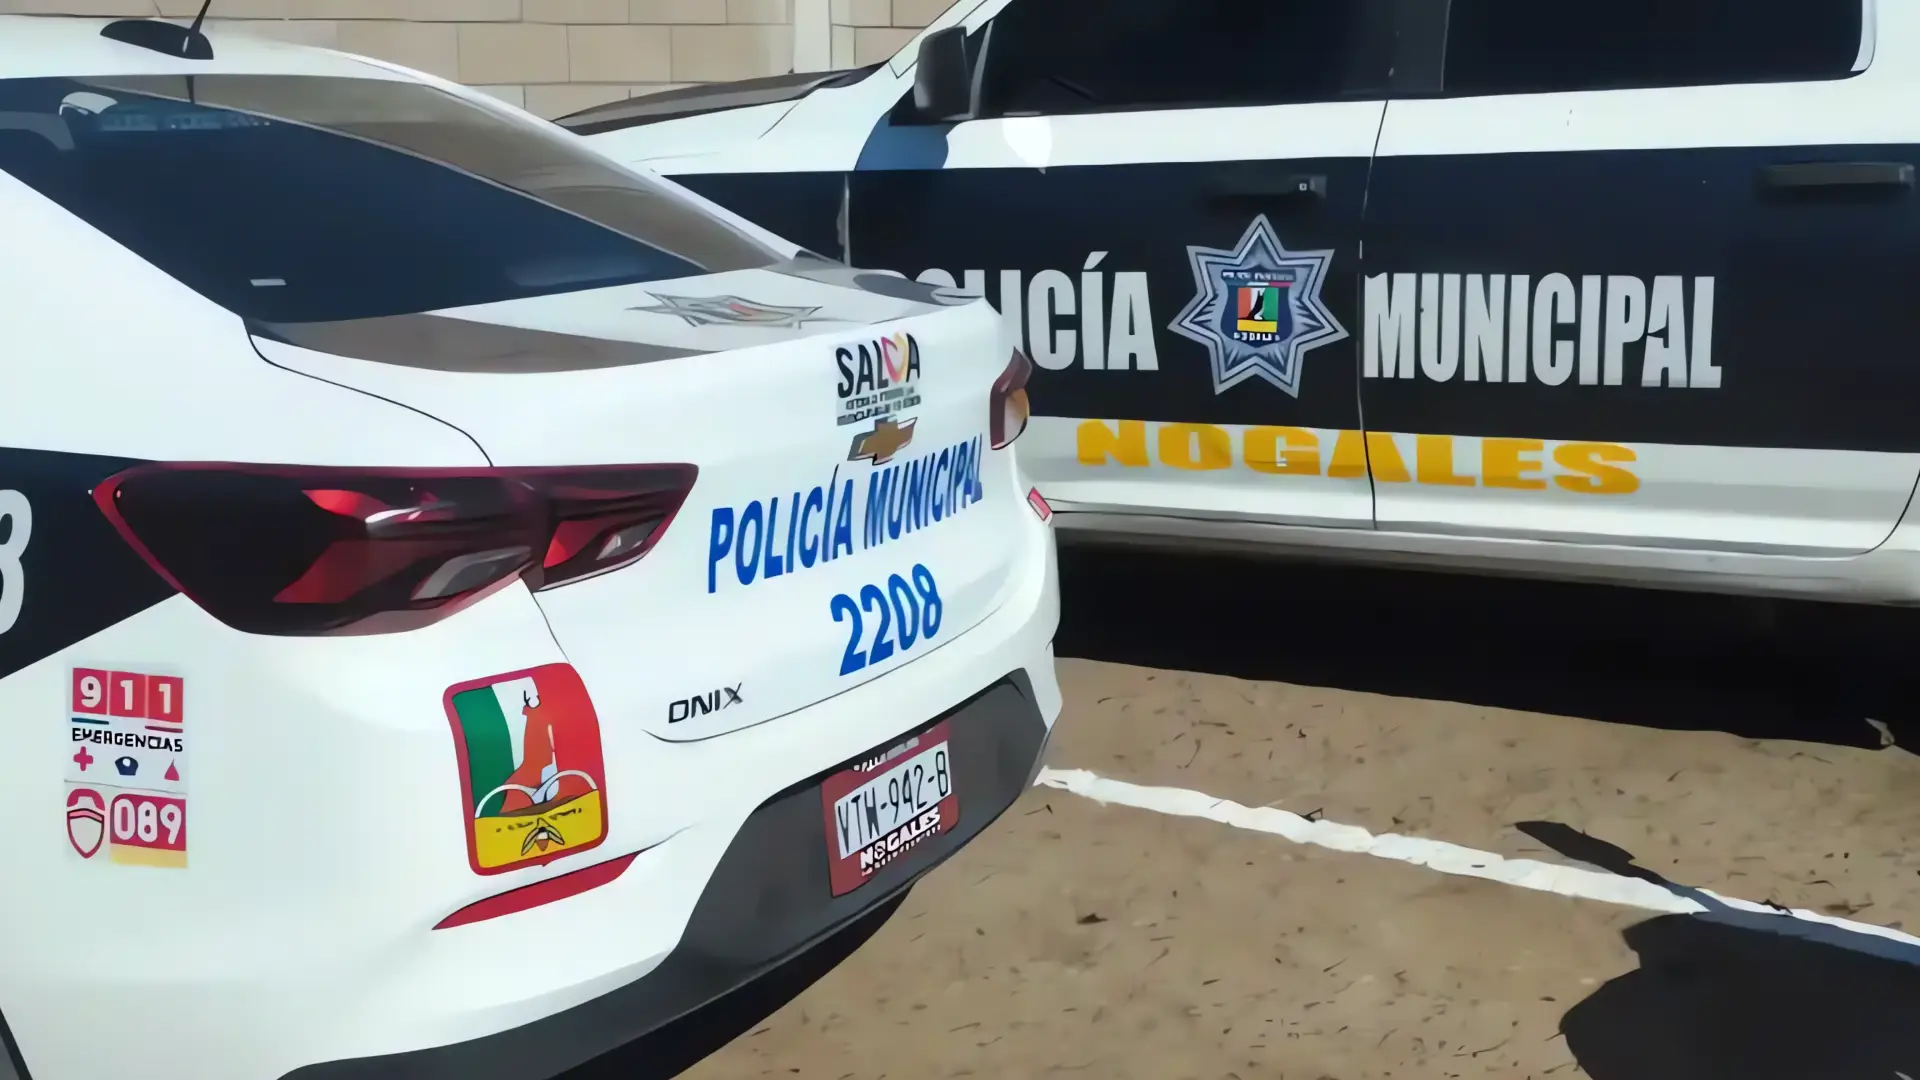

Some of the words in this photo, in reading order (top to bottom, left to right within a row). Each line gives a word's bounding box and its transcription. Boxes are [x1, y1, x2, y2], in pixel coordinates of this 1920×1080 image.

[1364, 272, 1722, 389] MUNICIPAL
[1076, 418, 1640, 495] NOGALES
[708, 463, 853, 593] POLICÍA
[863, 433, 982, 550] MUNICIPAL
[830, 563, 942, 676] 2208
[668, 681, 743, 723] ONIX
[114, 798, 182, 844] 089
